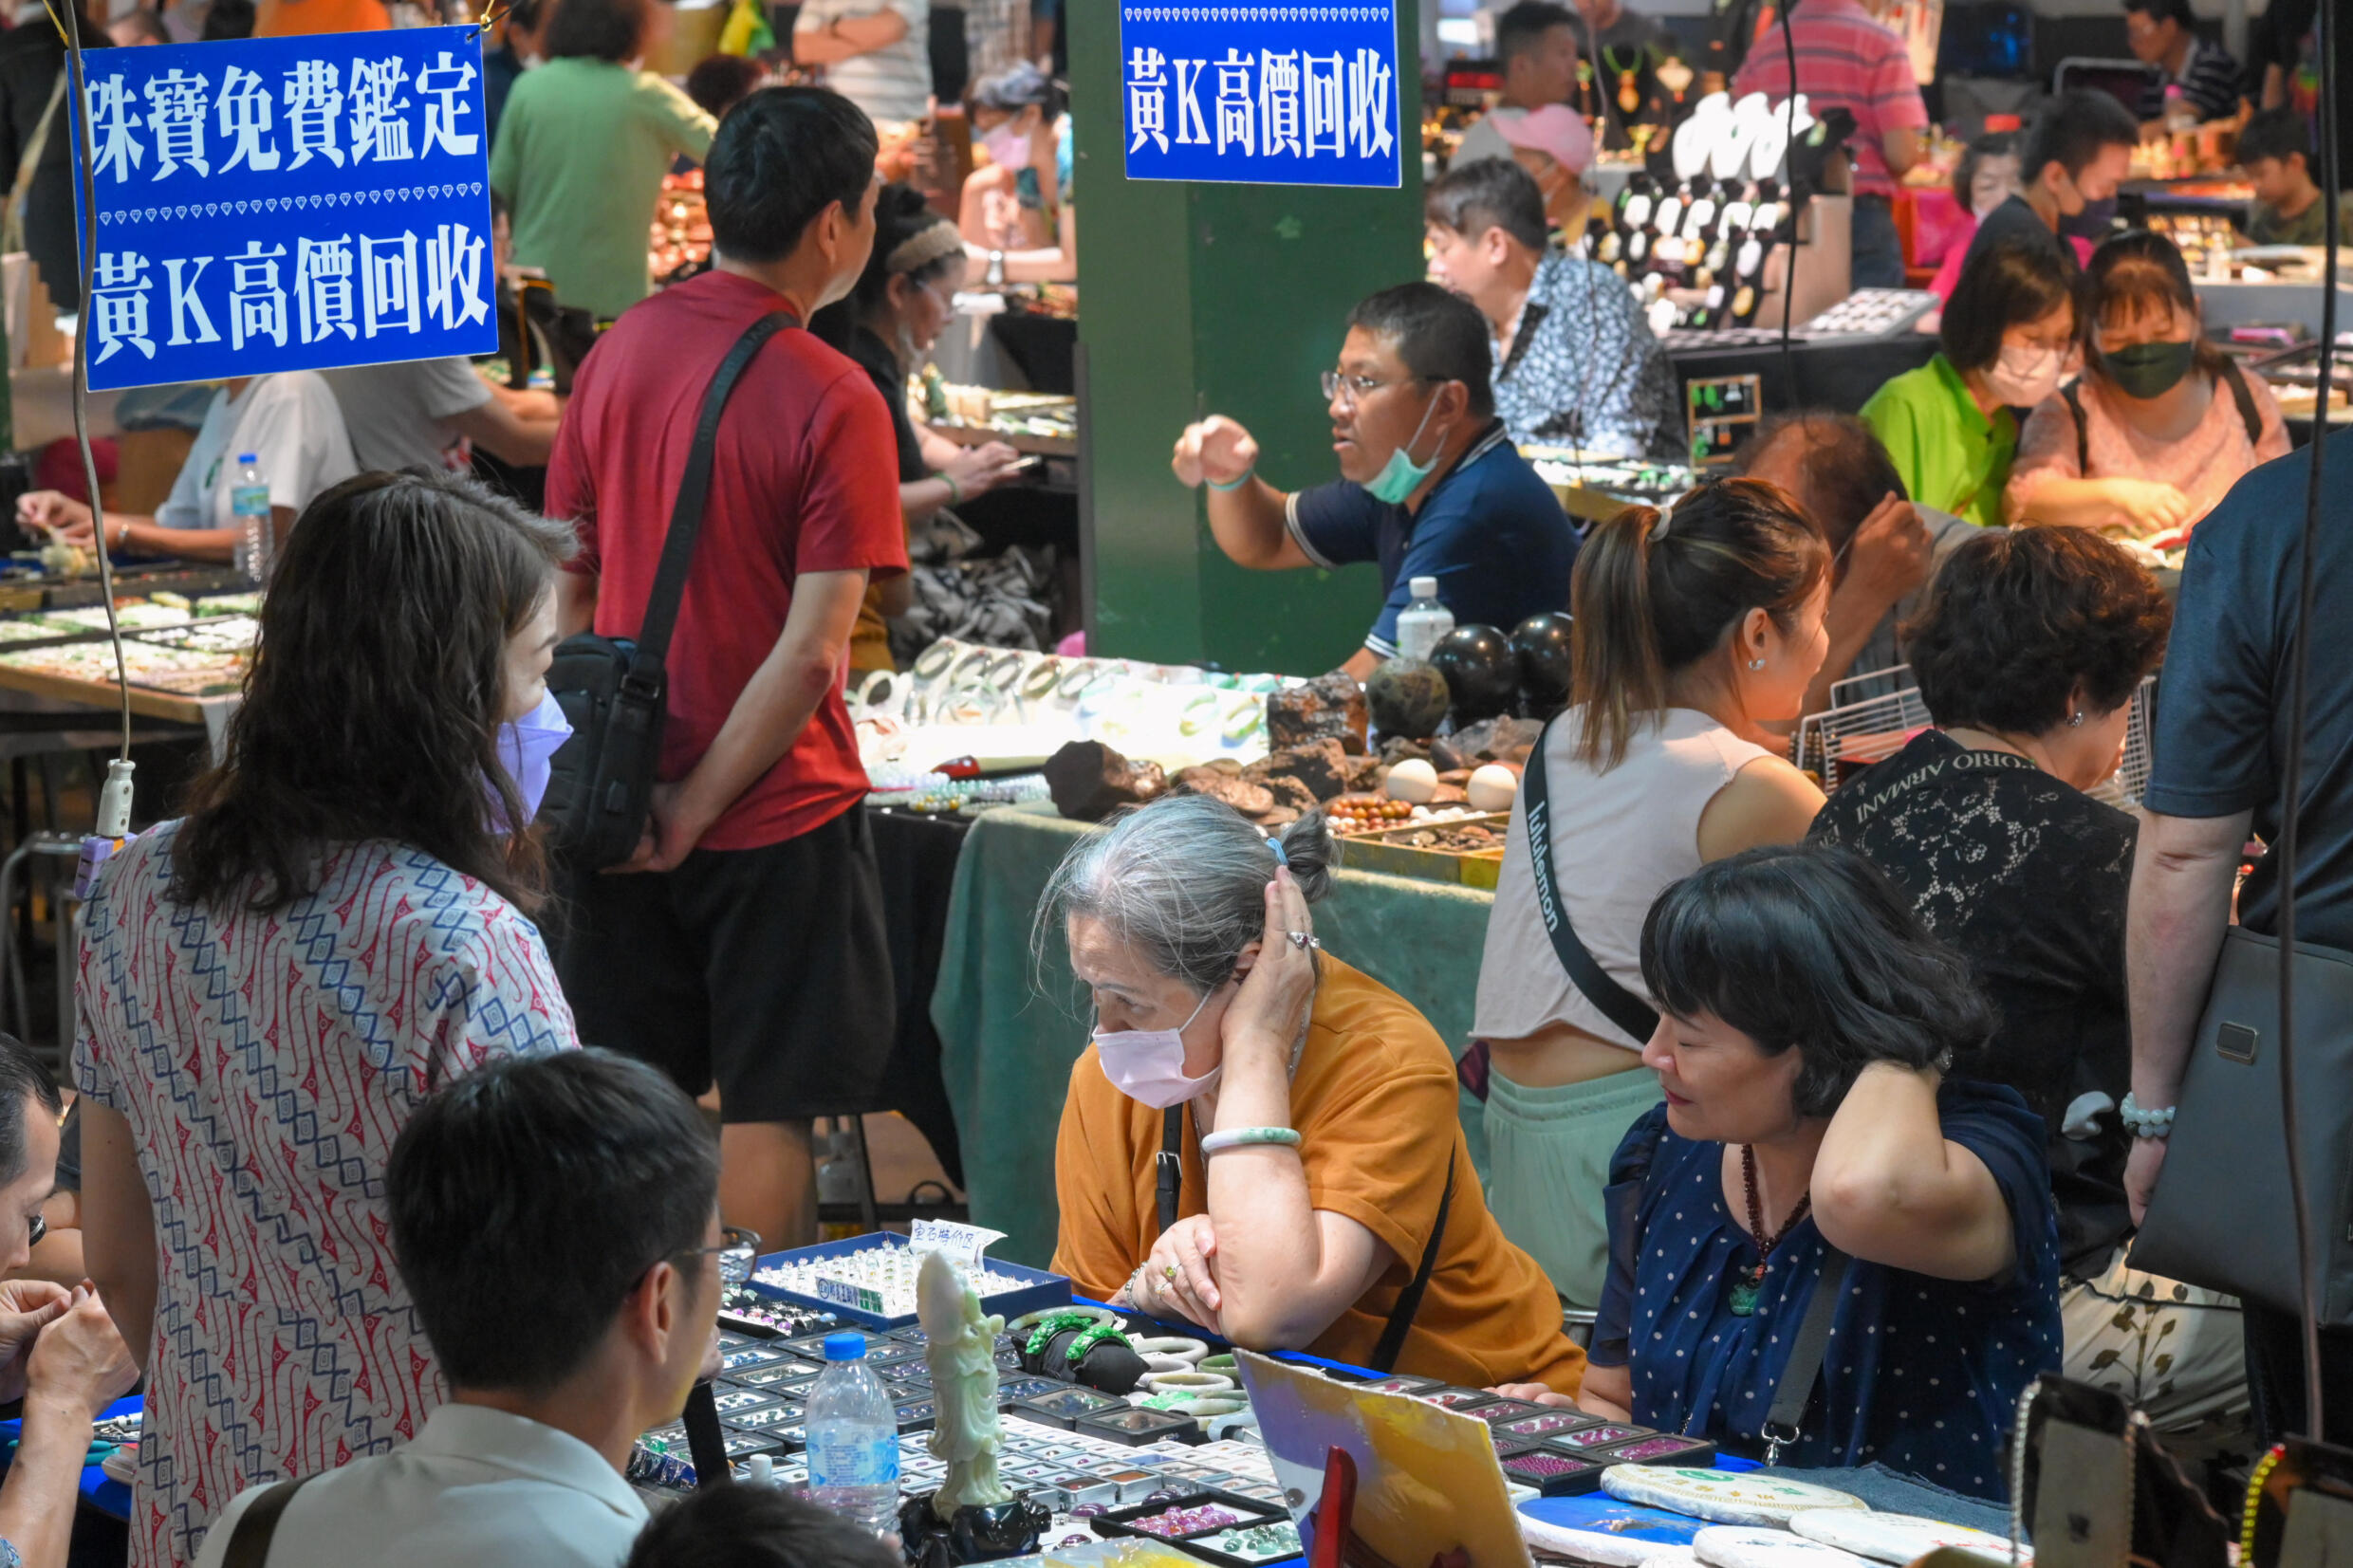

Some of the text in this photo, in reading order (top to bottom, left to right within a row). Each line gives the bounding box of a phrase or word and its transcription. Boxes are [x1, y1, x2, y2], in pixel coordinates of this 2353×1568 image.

[80, 51, 480, 184] 珠寶免費鑑定
[1126, 46, 1394, 159] 黃K高價回收
[91, 223, 490, 366] 黃K高價回收
[1856, 760, 1945, 824] ARMANI
[1528, 801, 1559, 932] lululemon
